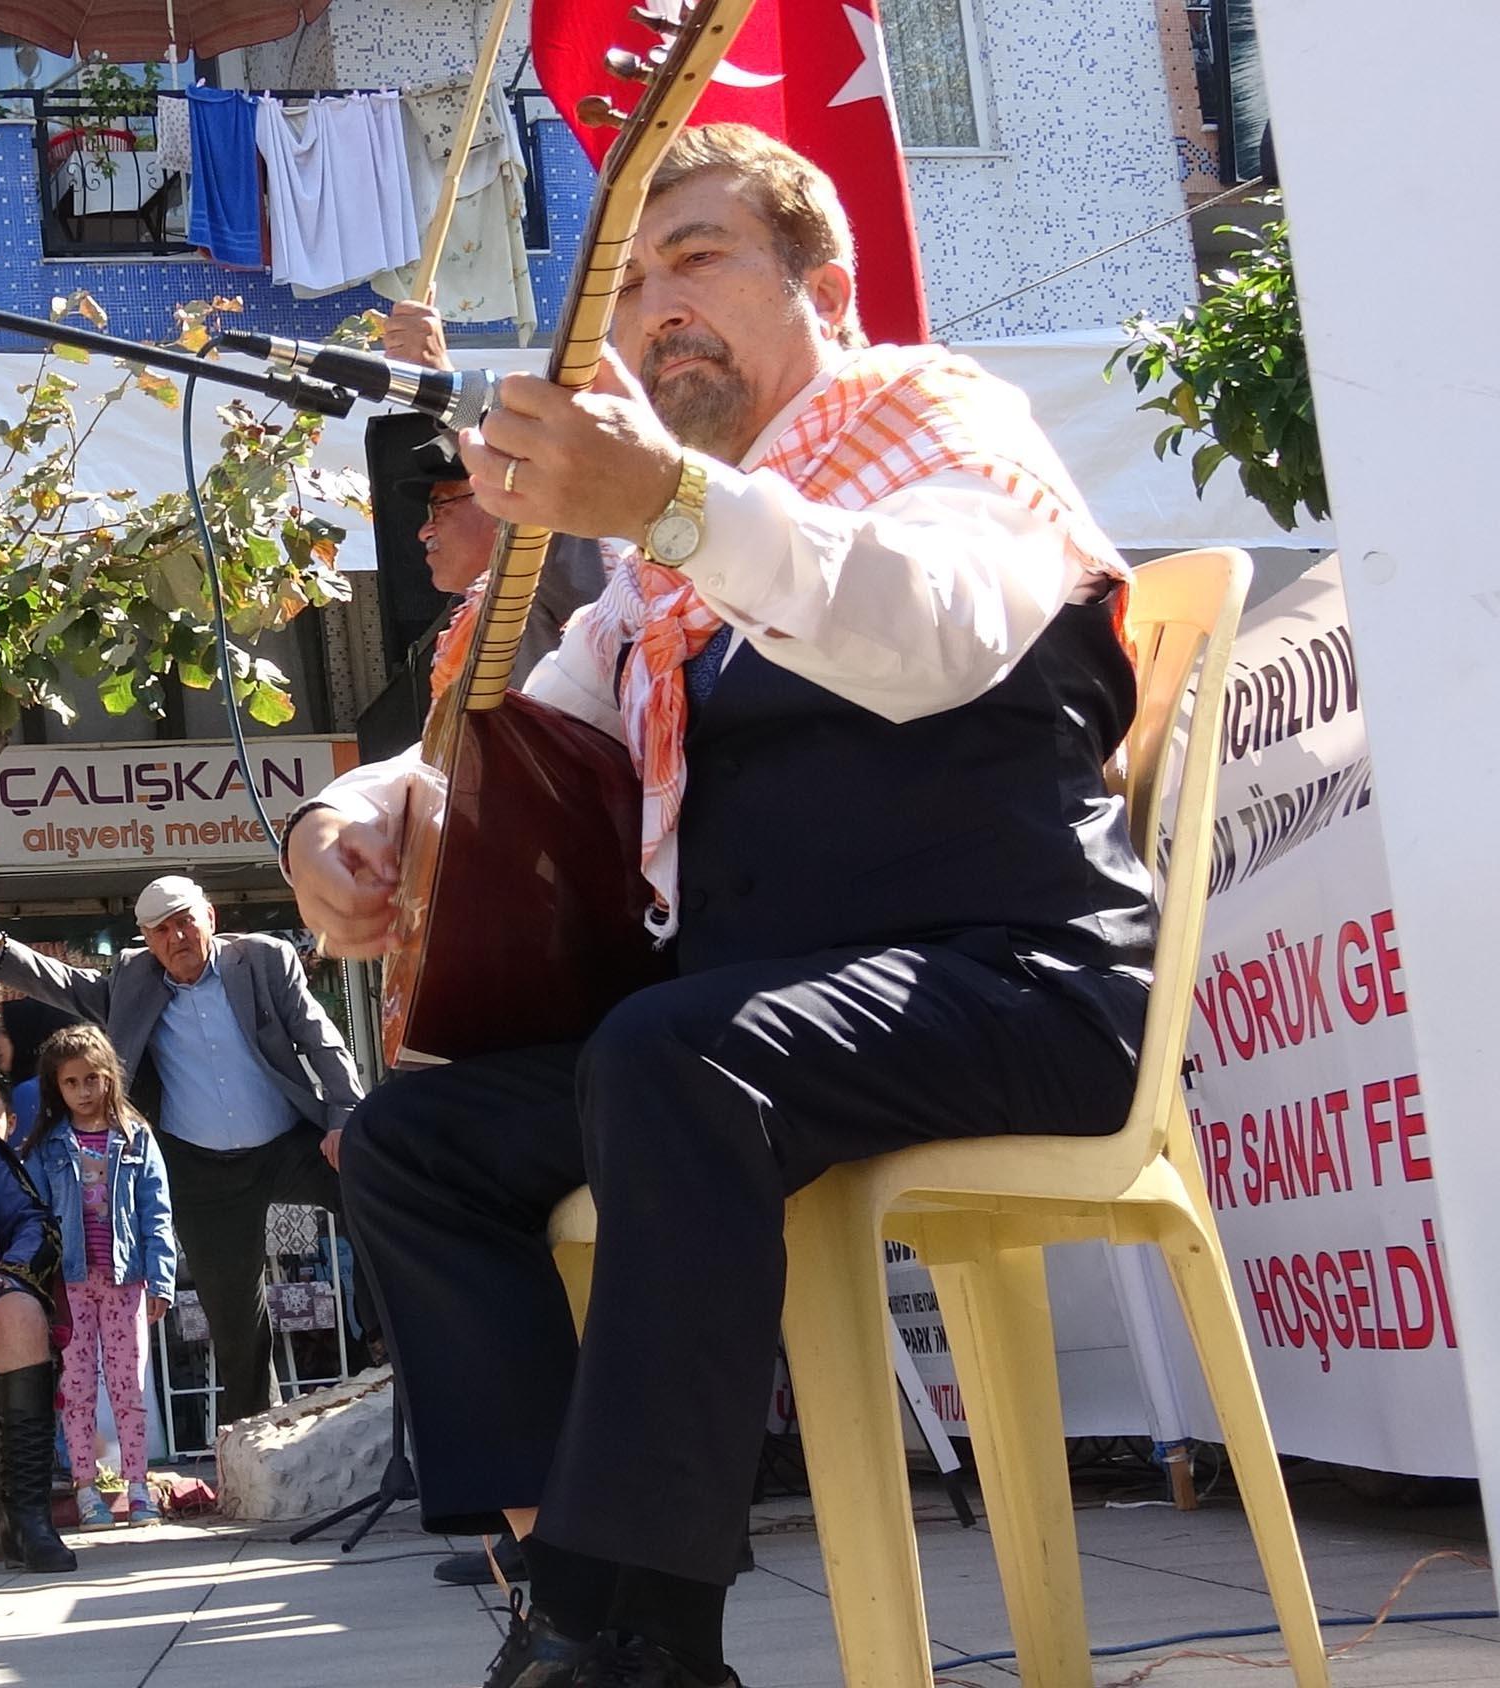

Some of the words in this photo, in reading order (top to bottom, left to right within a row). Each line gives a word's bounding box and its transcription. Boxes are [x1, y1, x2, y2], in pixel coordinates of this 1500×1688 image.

[0, 757, 306, 817] ÇALIŞKAN
[164, 812, 291, 847] merkez
[1193, 928, 1334, 1067] YÖRÜK
[1240, 1089, 1353, 1207] SANAT
